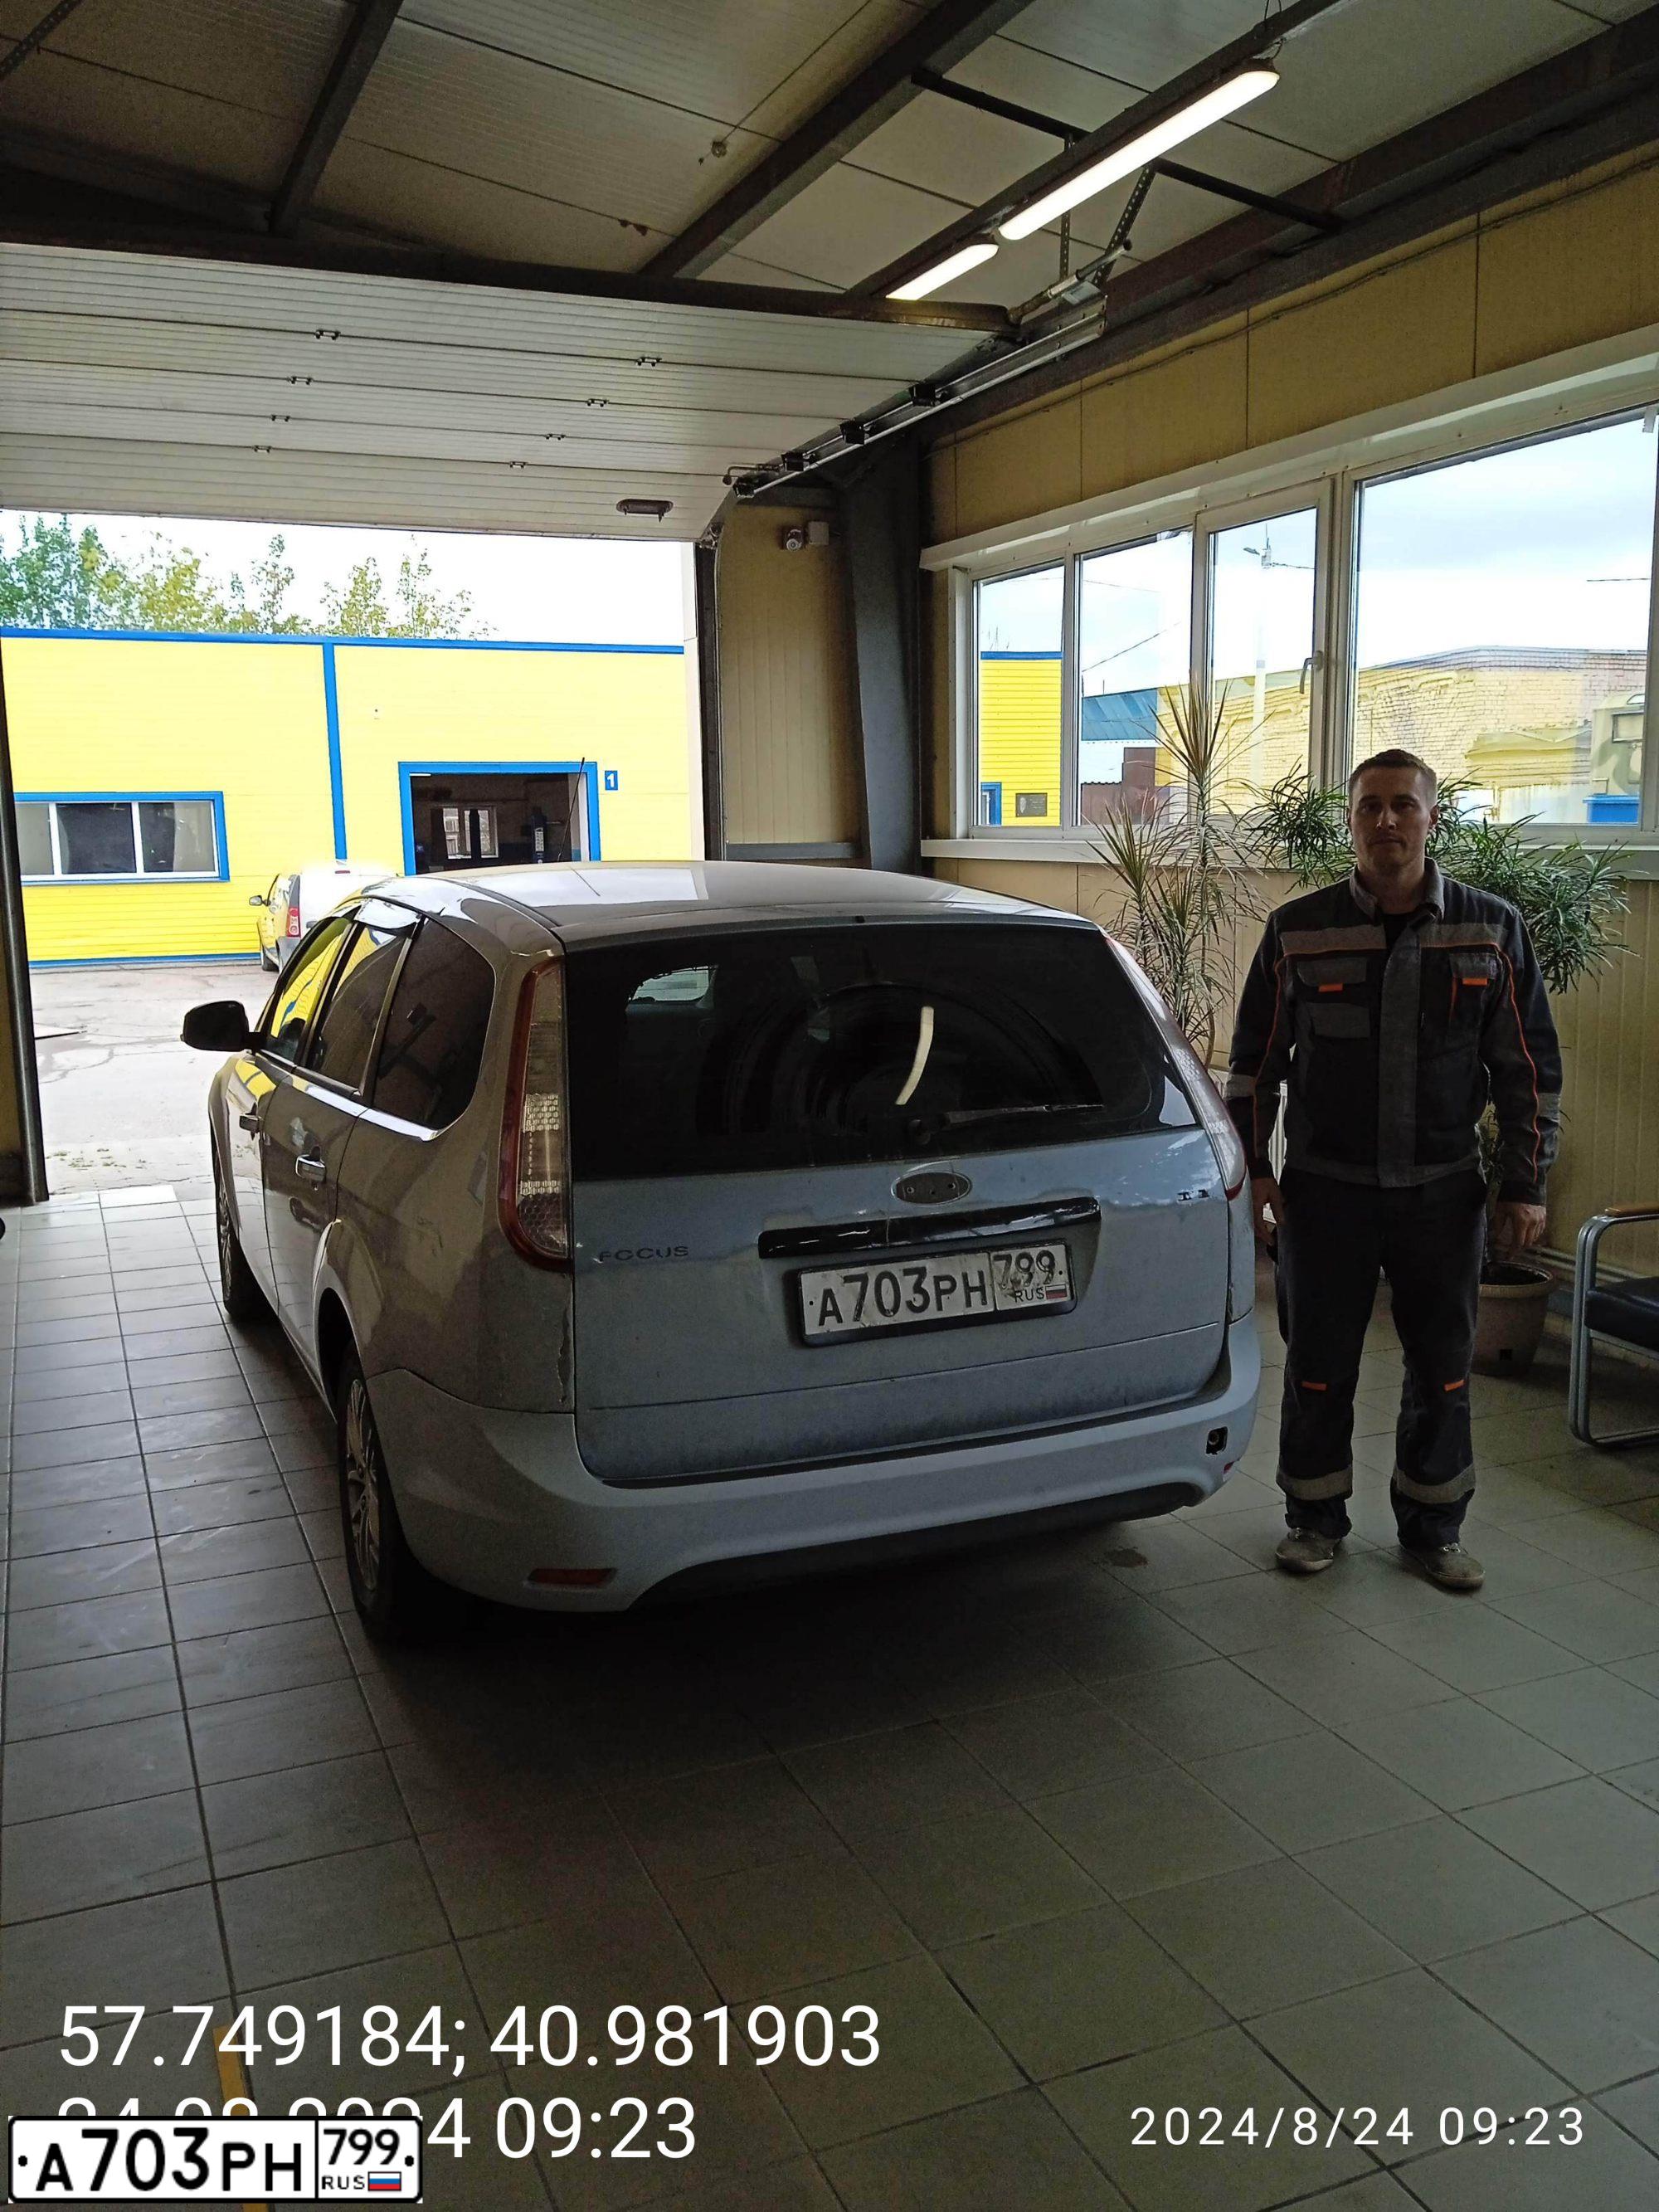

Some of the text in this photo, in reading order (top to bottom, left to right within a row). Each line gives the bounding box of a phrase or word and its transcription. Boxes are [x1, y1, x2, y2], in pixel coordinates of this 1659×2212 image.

[607, 773, 615, 787] 1
[993, 1250, 1056, 1289] 799
[1014, 1286, 1045, 1303] RUS
